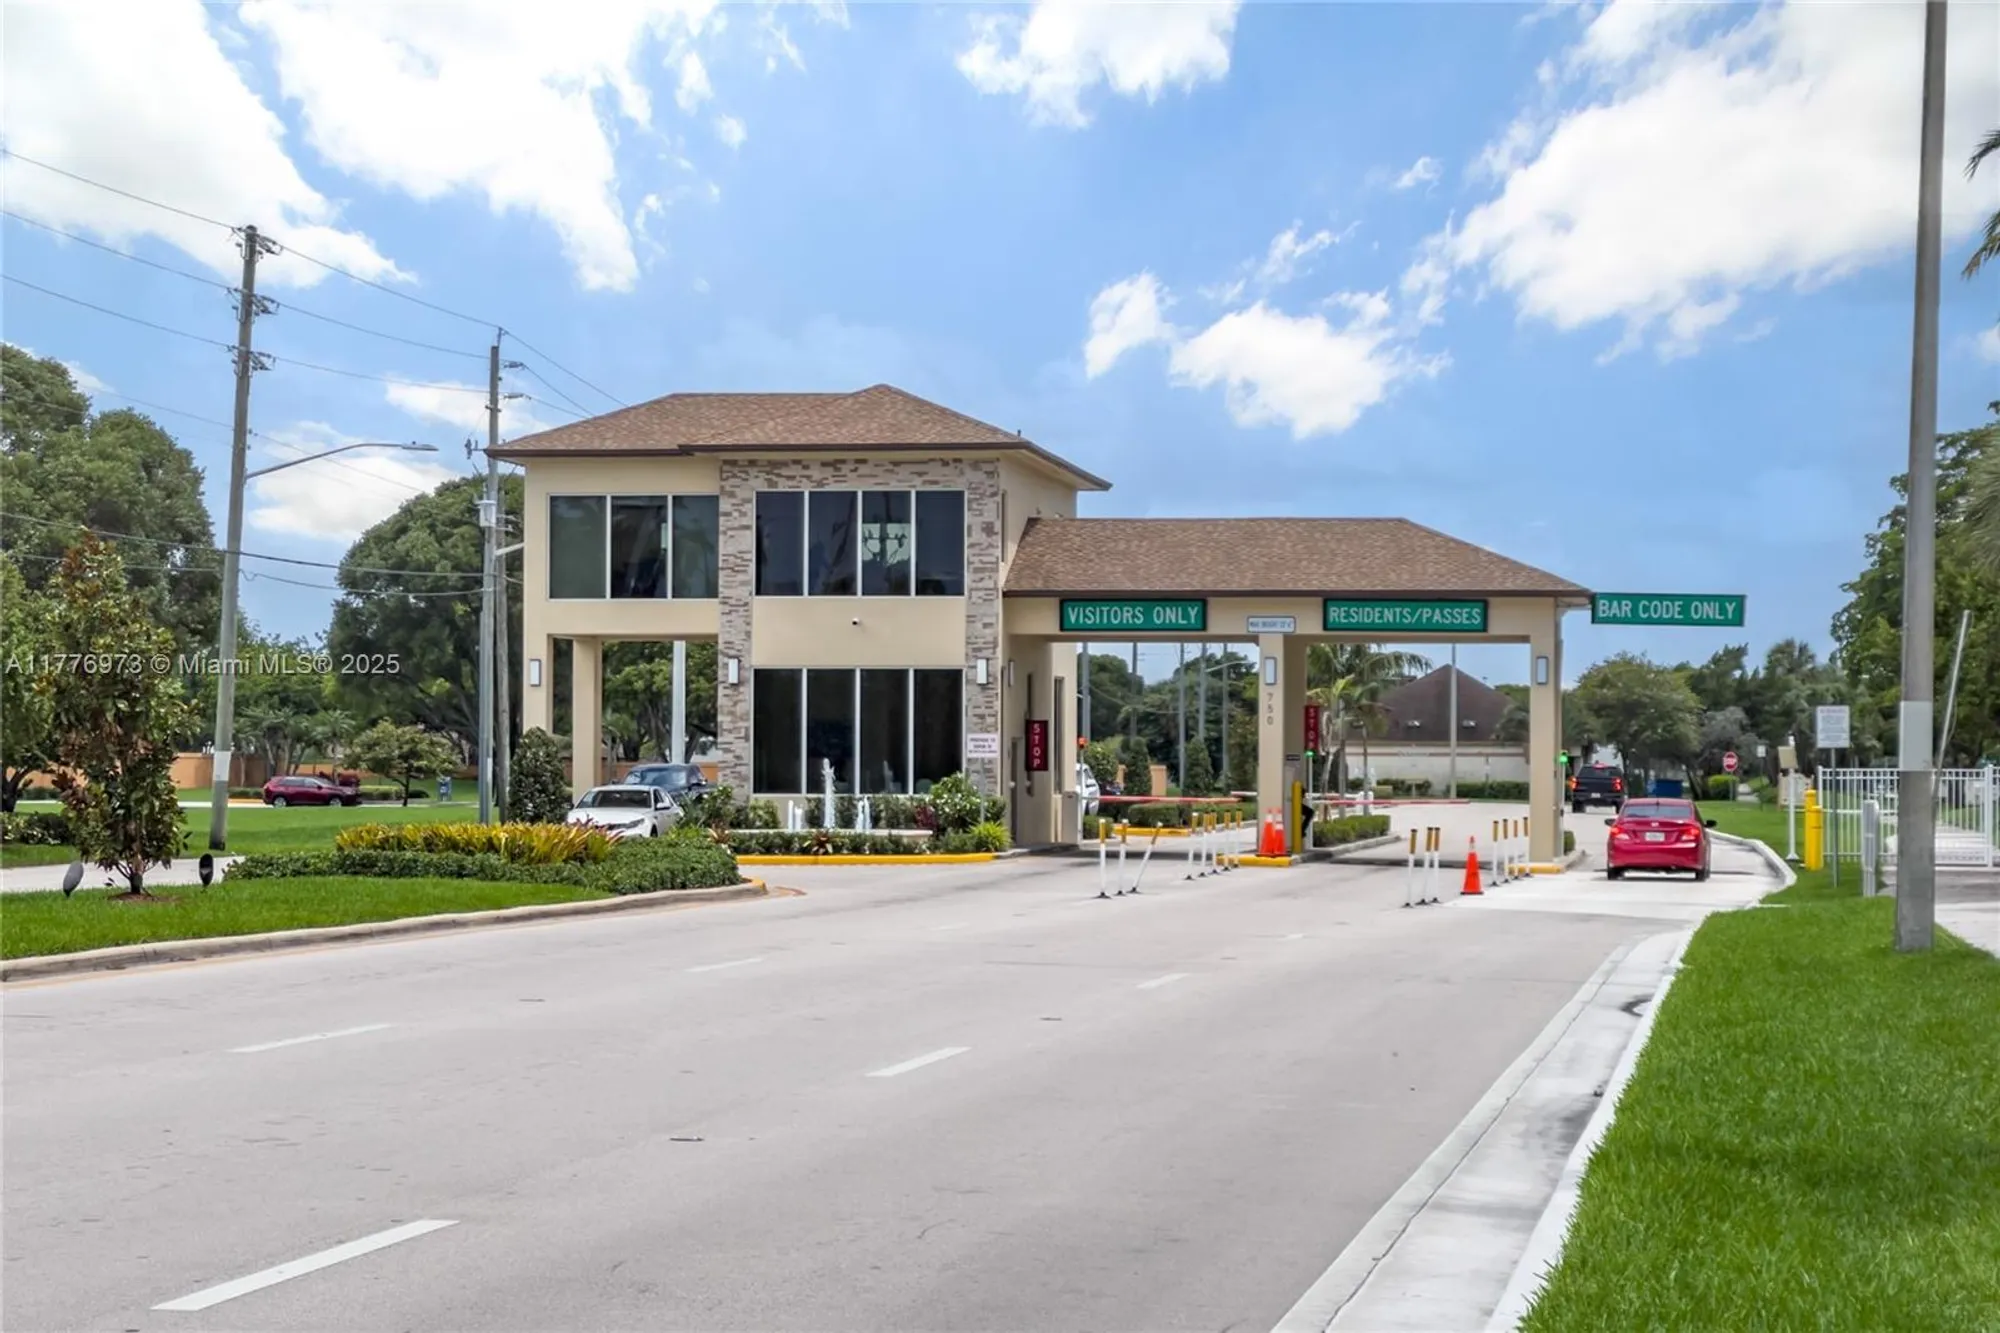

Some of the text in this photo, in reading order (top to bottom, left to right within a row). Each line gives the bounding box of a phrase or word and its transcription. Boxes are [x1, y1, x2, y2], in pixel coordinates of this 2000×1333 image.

[1067, 606, 1198, 624] VISITORS ONLY
[1329, 607, 1481, 624] RESIDENTS/PASSES
[1599, 600, 1736, 620] BAR CODE ONLY
[1033, 723, 1041, 768] STOP
